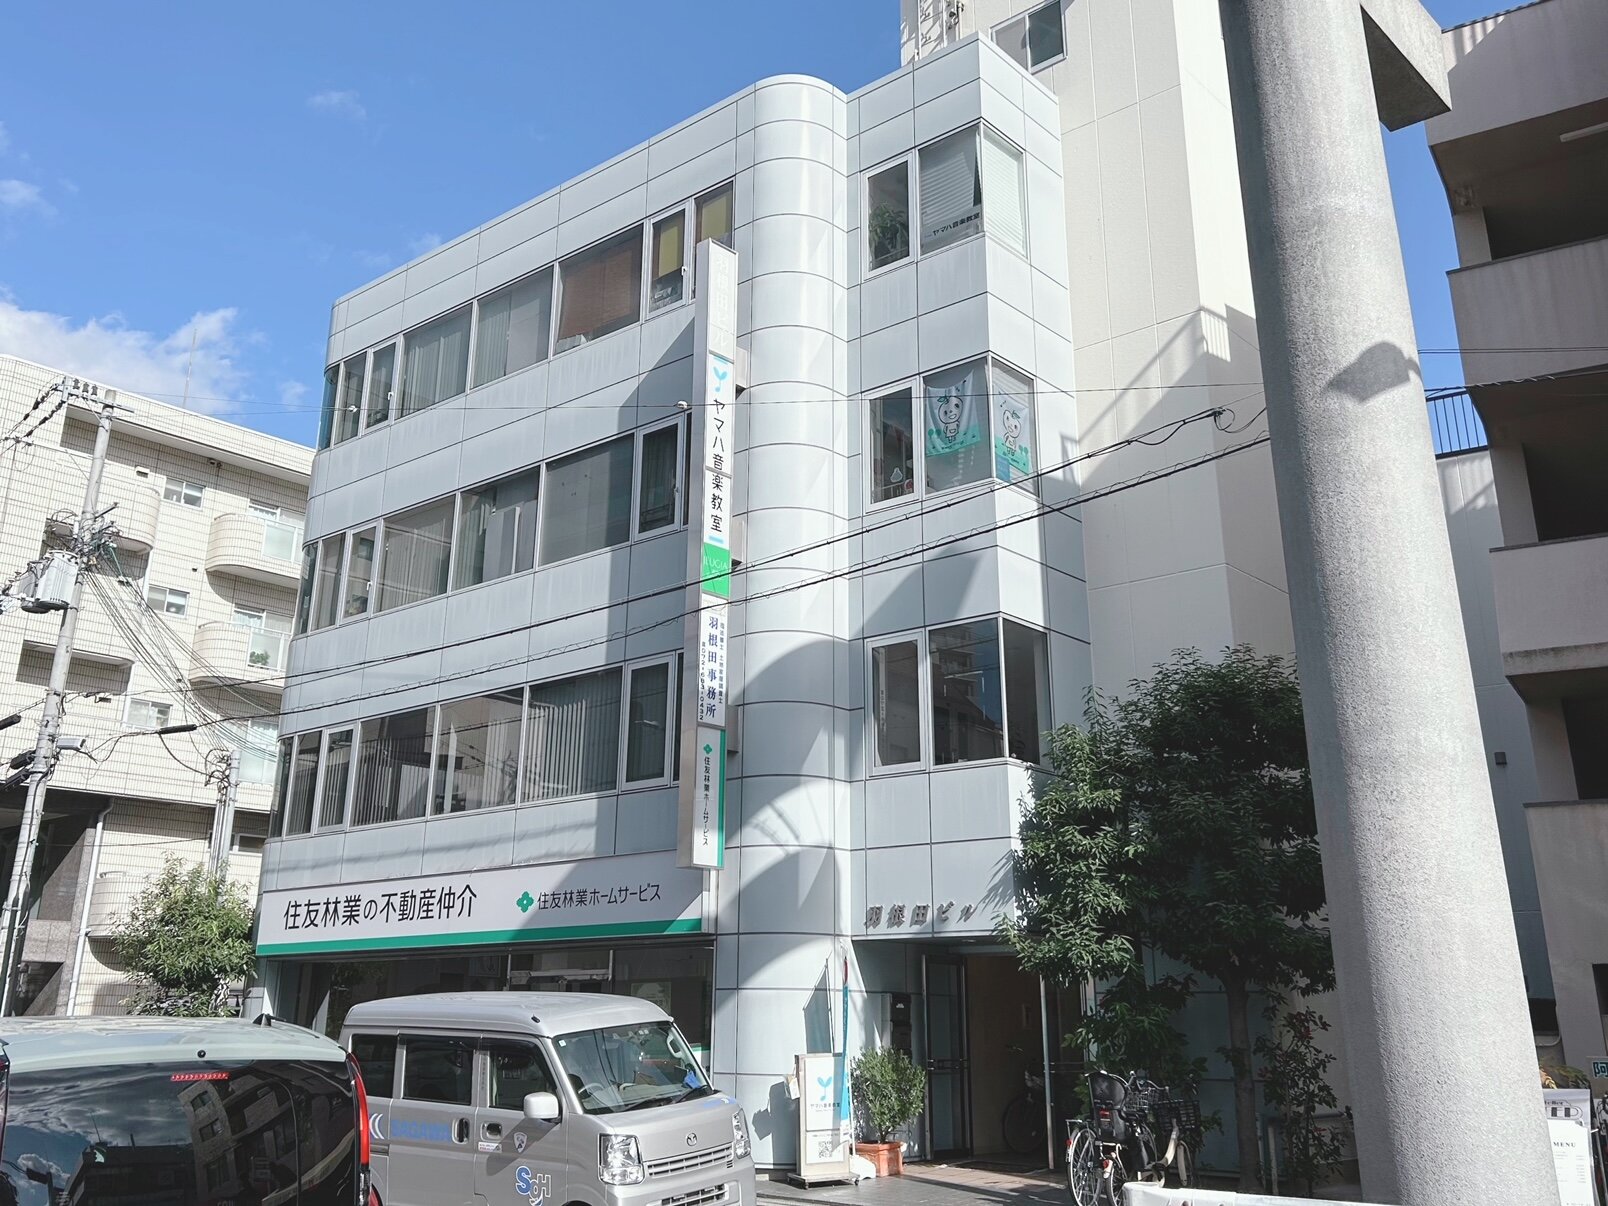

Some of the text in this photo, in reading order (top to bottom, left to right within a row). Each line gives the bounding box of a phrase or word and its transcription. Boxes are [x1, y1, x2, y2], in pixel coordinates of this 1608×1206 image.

[710, 398, 725, 533] ヤマハ音楽教室
[705, 616, 719, 718] 羽根田事務所
[703, 756, 711, 846] 住友林業ホームサービス
[283, 884, 477, 931] 住友林業の不動産仲介
[537, 882, 661, 910] 住友林業ホームサービス
